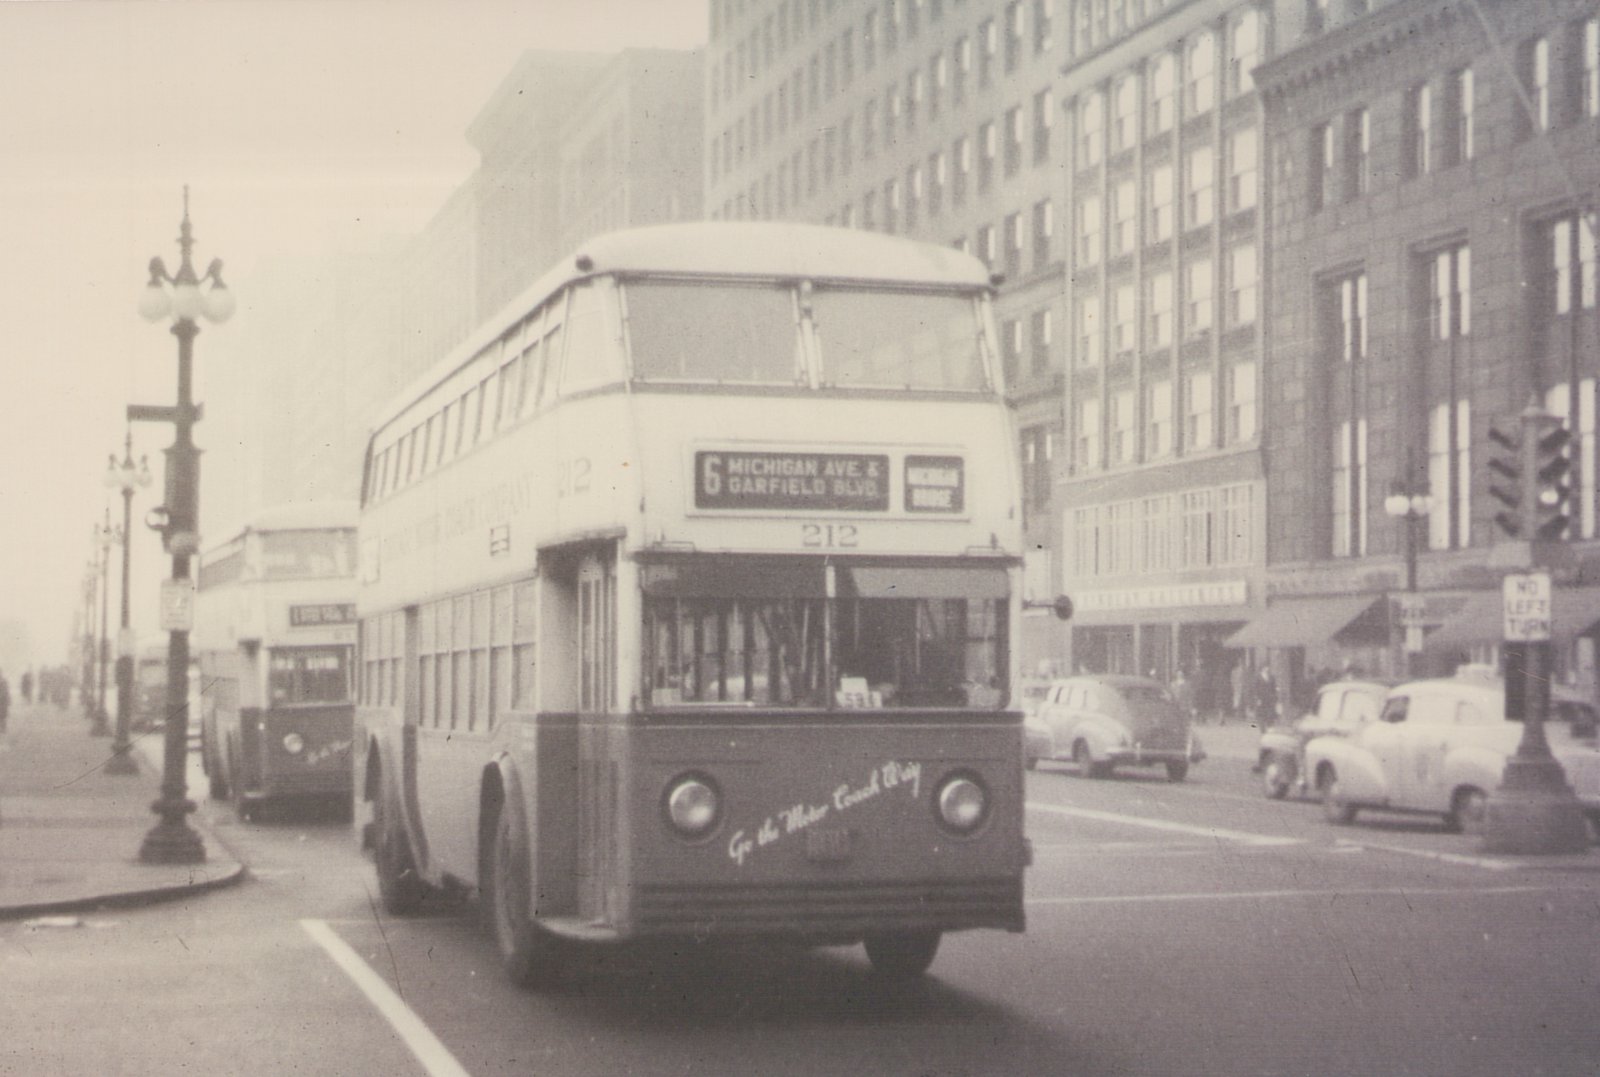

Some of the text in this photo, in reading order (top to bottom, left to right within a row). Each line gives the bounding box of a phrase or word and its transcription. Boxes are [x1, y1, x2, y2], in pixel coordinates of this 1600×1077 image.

[704, 455, 721, 495] 6
[728, 458, 818, 477] MICHIGAN
[867, 461, 879, 477] &
[728, 476, 826, 496] GARFIELD
[802, 525, 858, 547] 212
[1516, 580, 1538, 595] NO
[1507, 599, 1546, 615] LEFT
[1508, 618, 1548, 634] TURN
[728, 830, 754, 866] Go
[758, 817, 780, 846] the
[833, 769, 881, 810] Coach
[882, 760, 921, 798] Way
